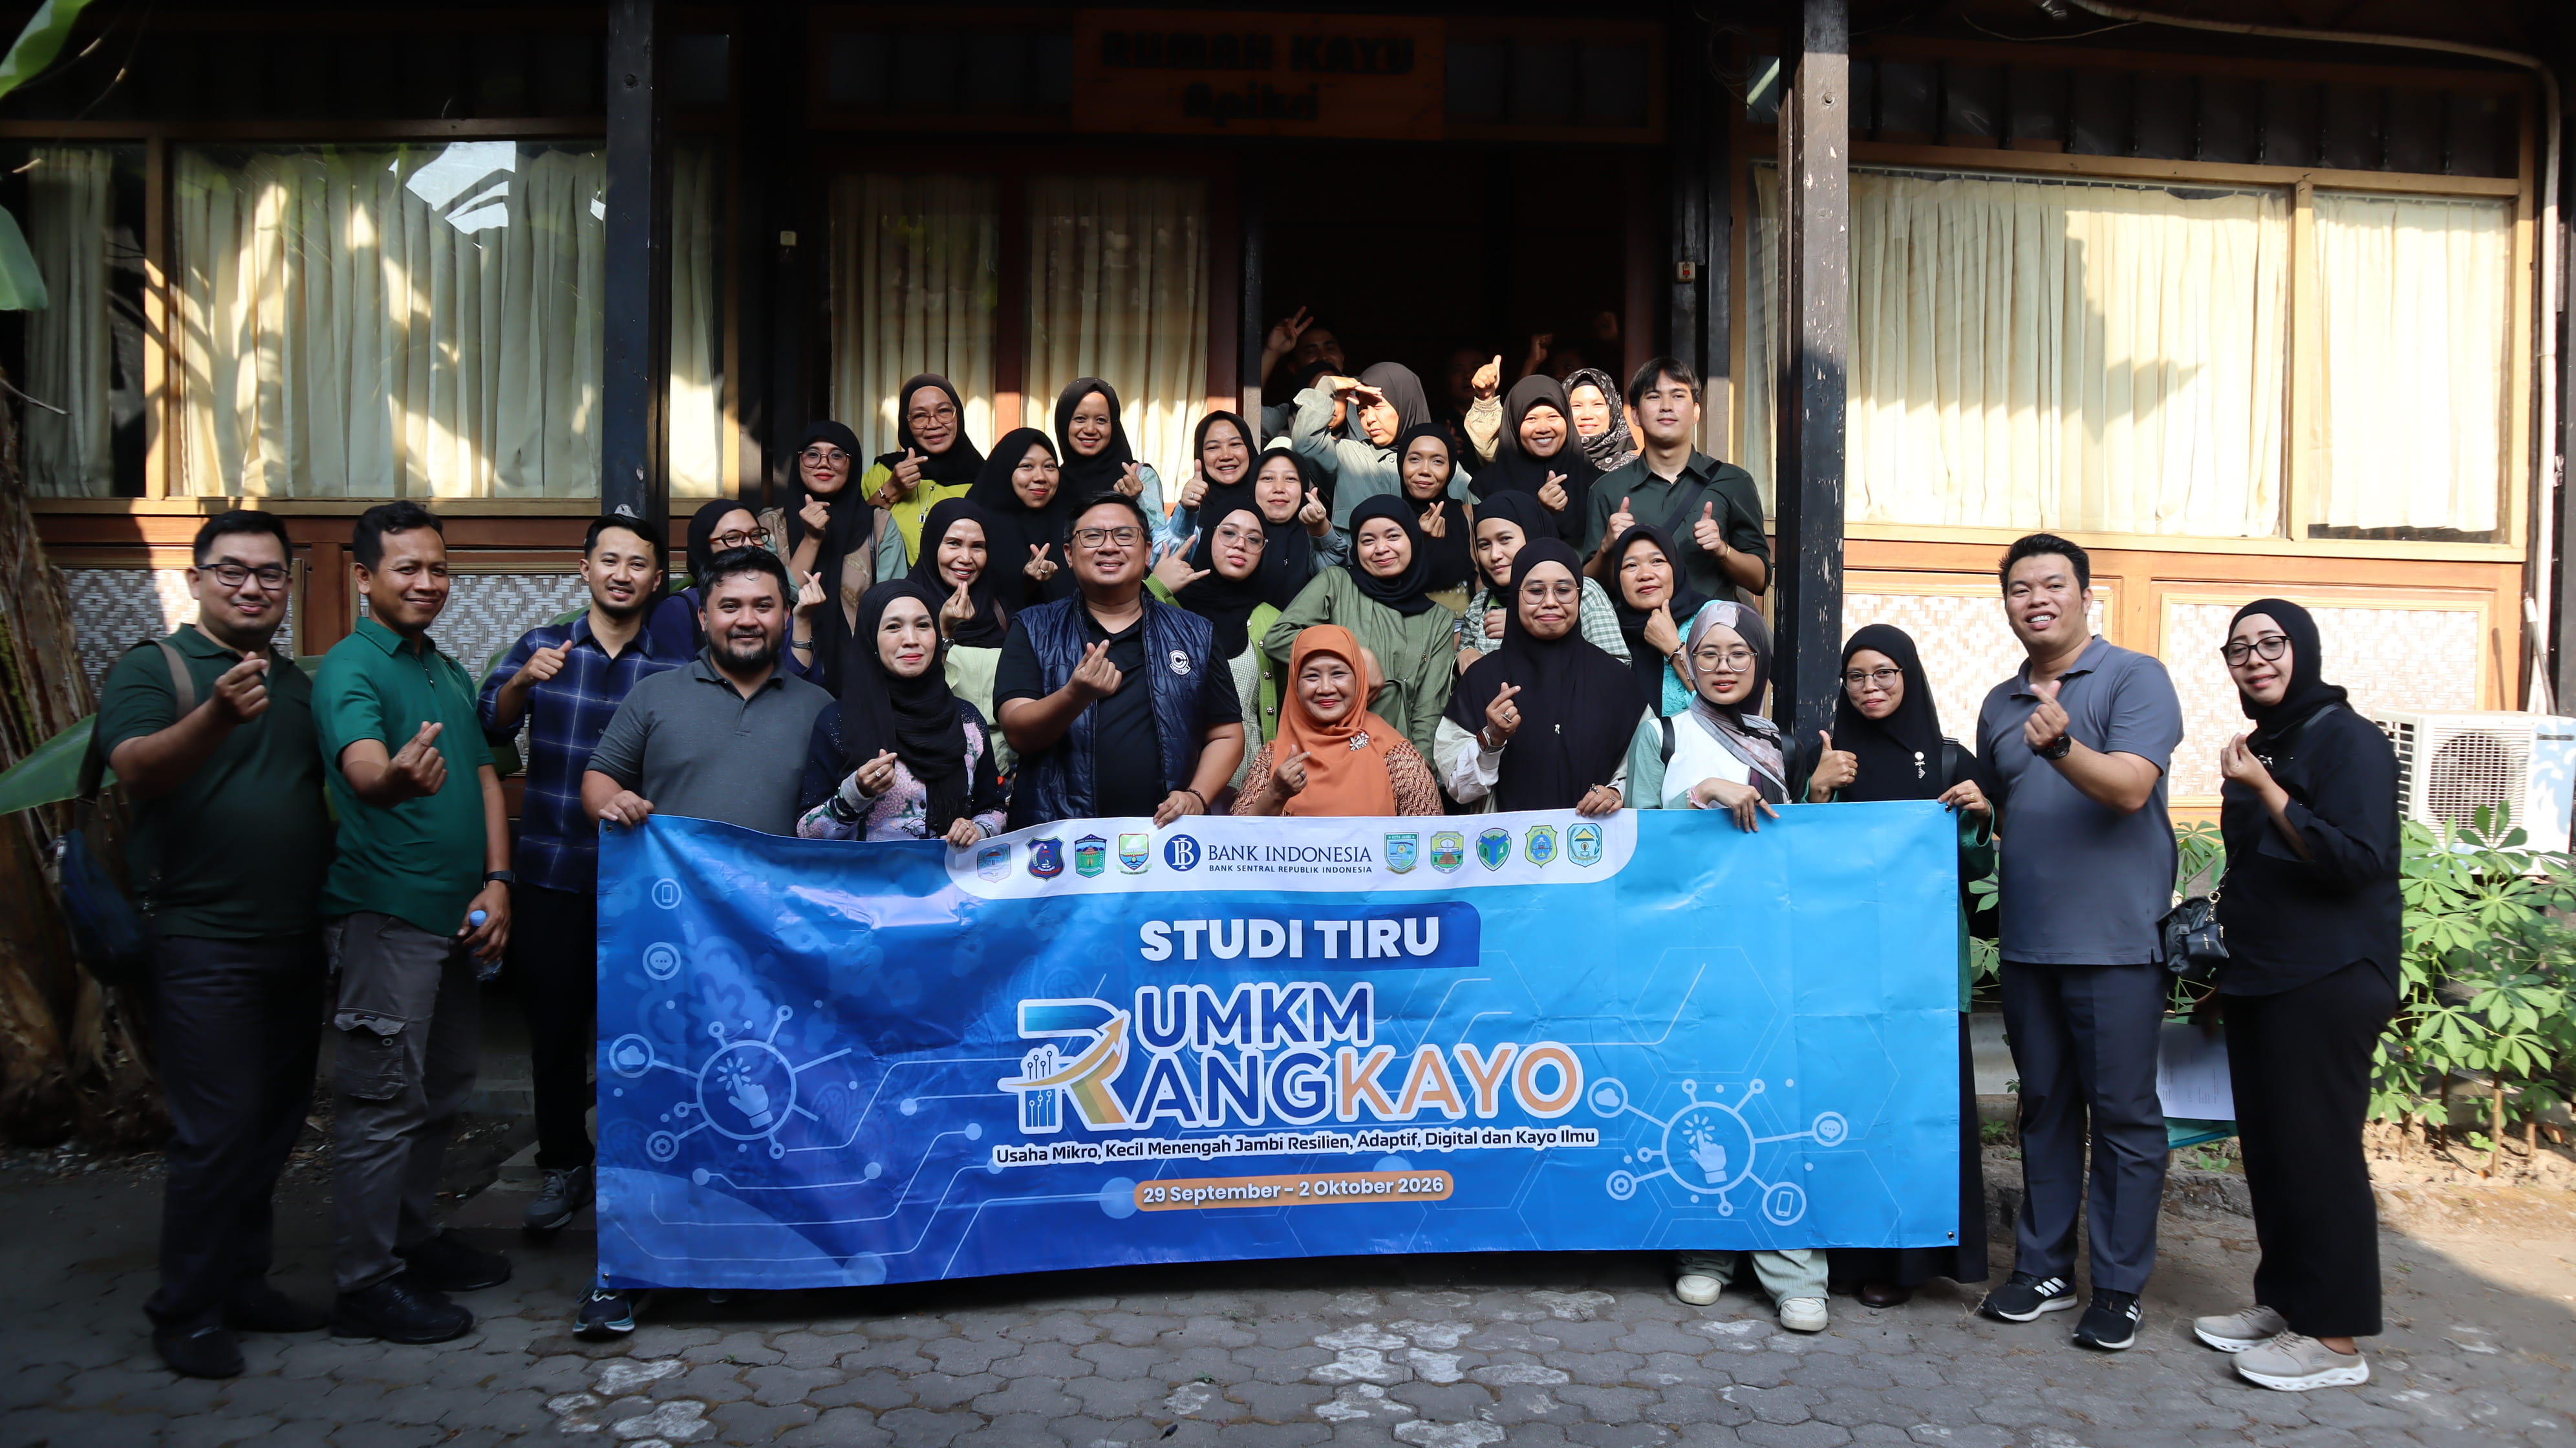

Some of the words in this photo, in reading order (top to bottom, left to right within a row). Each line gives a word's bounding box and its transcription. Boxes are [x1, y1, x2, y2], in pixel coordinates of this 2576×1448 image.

[1101, 30, 1273, 70] RUMAH
[1290, 35, 1415, 74] KAYU
[1208, 845, 1259, 861] BANK
[1265, 846, 1372, 862] INDONESIA
[1140, 919, 1302, 961] STUDI
[1313, 916, 1439, 959] TIRU
[1141, 988, 1368, 1047] UMKM
[996, 1148, 1048, 1163] Usaha
[1053, 1146, 1102, 1160] Mikro,
[1106, 1142, 1143, 1157] Kecil
[1148, 1140, 1229, 1158] Menengah
[1235, 1136, 1283, 1151] Jambi
[1288, 1134, 1353, 1150] Resilien,
[1358, 1132, 1421, 1149] Adaptif,
[1425, 1131, 1477, 1148] Digital
[1481, 1131, 1512, 1145] dan
[1516, 1131, 1556, 1146] Kayo
[1561, 1129, 1595, 1144] Ilmu
[1143, 1186, 1165, 1203] 29
[1170, 1183, 1281, 1206] September
[1299, 1181, 1310, 1197] 2
[1314, 1178, 1394, 1195] Oktober
[1397, 1176, 1444, 1193] 2026
